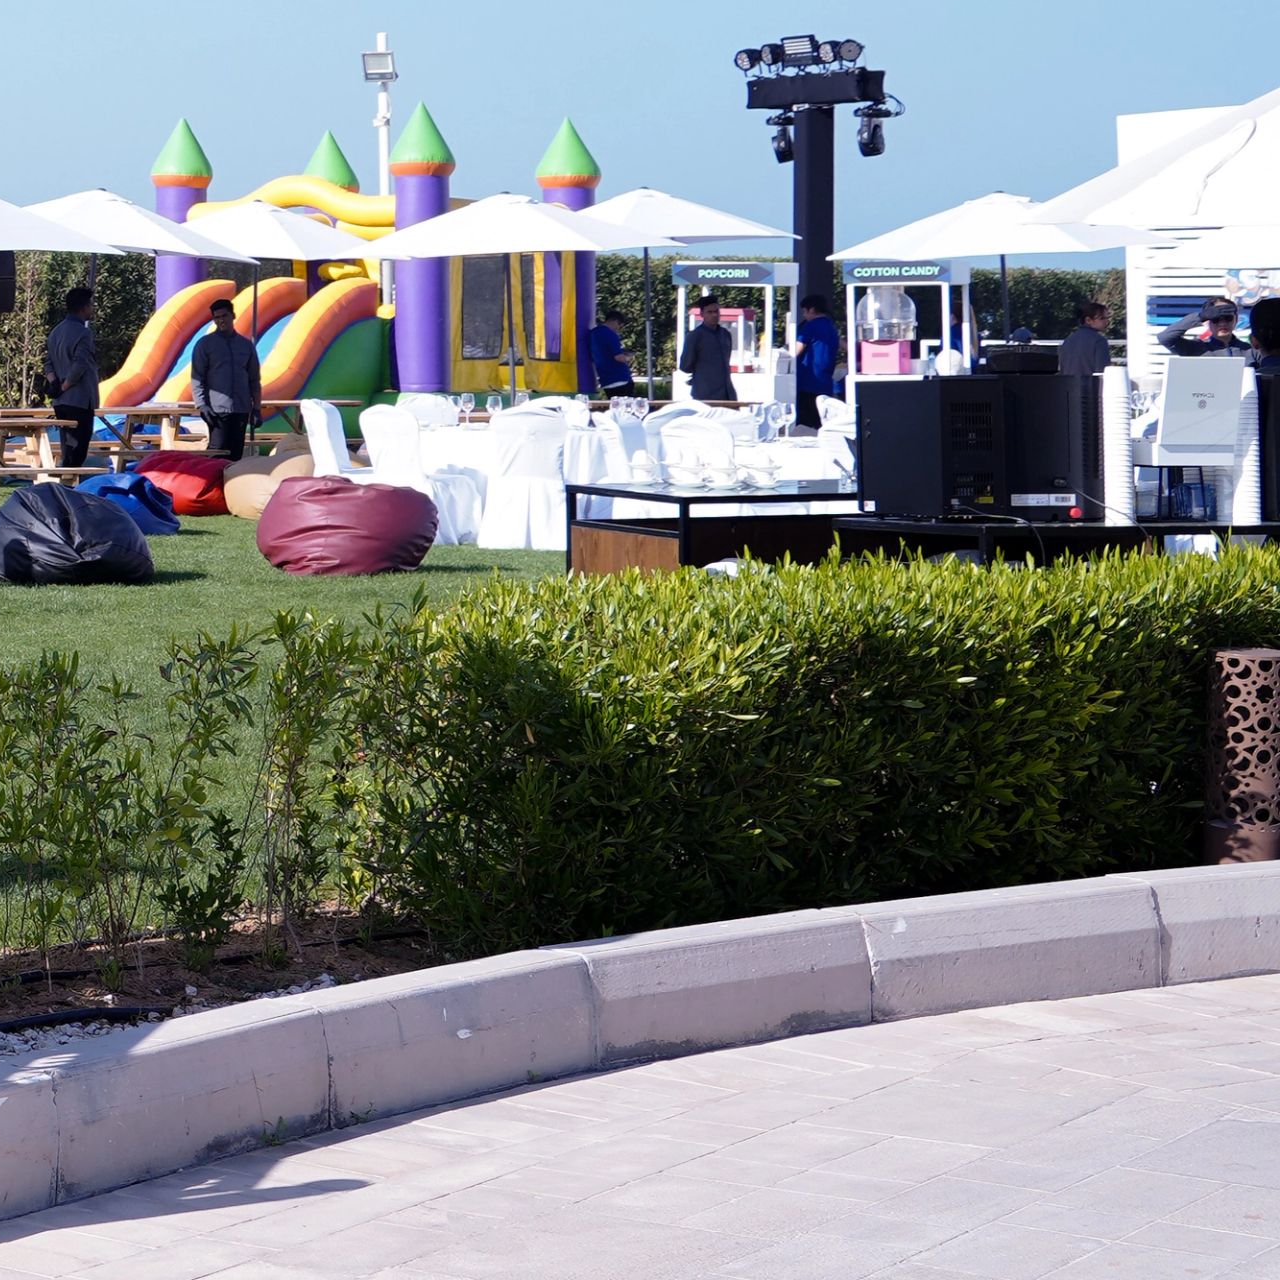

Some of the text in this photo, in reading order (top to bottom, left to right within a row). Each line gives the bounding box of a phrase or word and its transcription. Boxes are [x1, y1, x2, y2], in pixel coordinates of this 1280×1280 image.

[697, 268, 750, 279] POPCORN
[852, 265, 940, 278] COTTON CANDY
